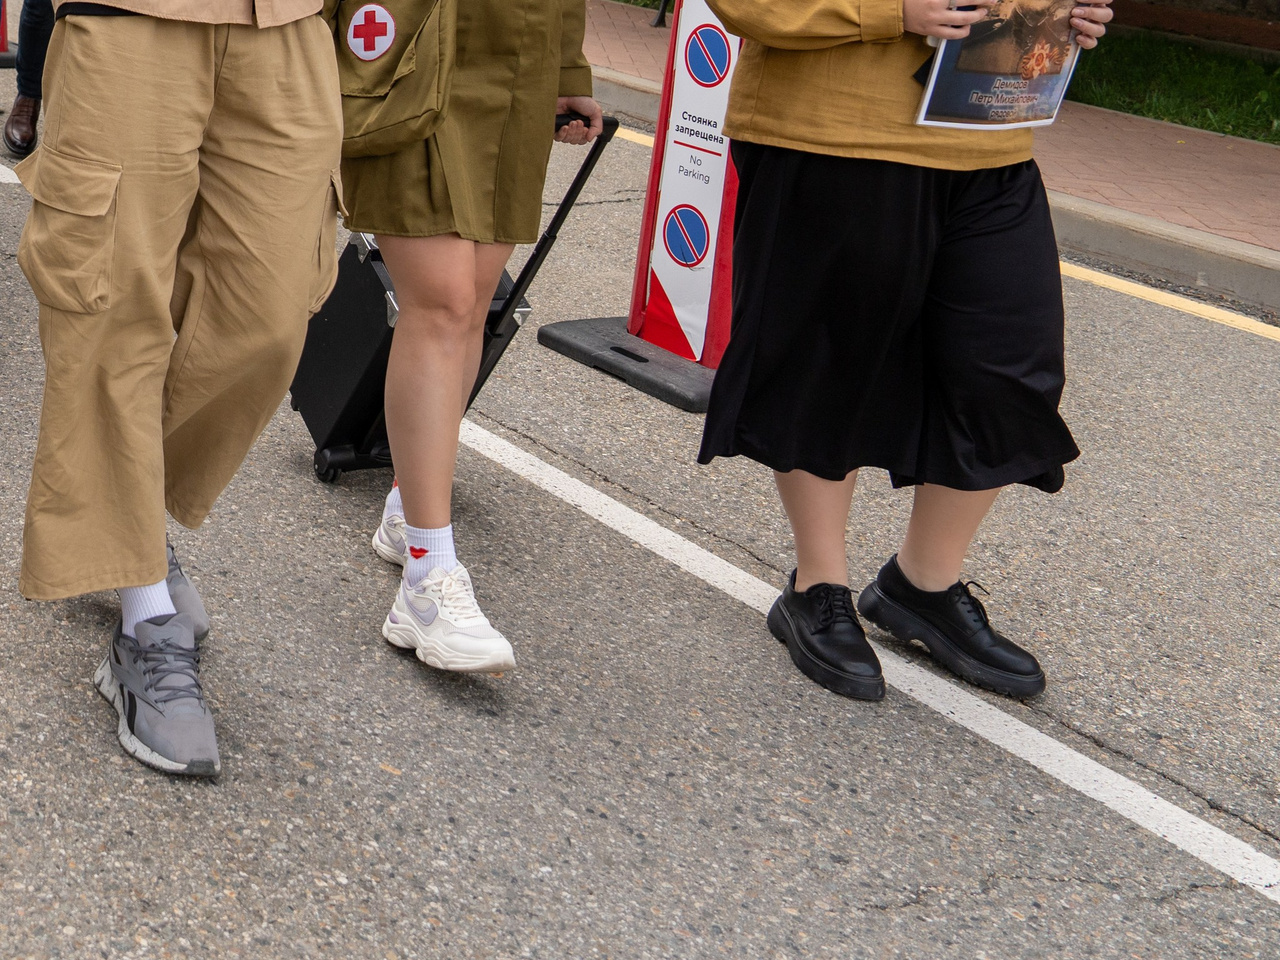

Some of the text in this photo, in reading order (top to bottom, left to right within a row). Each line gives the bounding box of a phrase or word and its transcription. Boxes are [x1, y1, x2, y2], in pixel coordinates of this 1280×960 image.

[992, 78, 1028, 90] Демидов
[971, 91, 993, 105] Петр
[681, 111, 718, 129] Стоянка
[674, 124, 724, 145] запрещена
[689, 155, 703, 167] No
[678, 165, 710, 185] Parking
